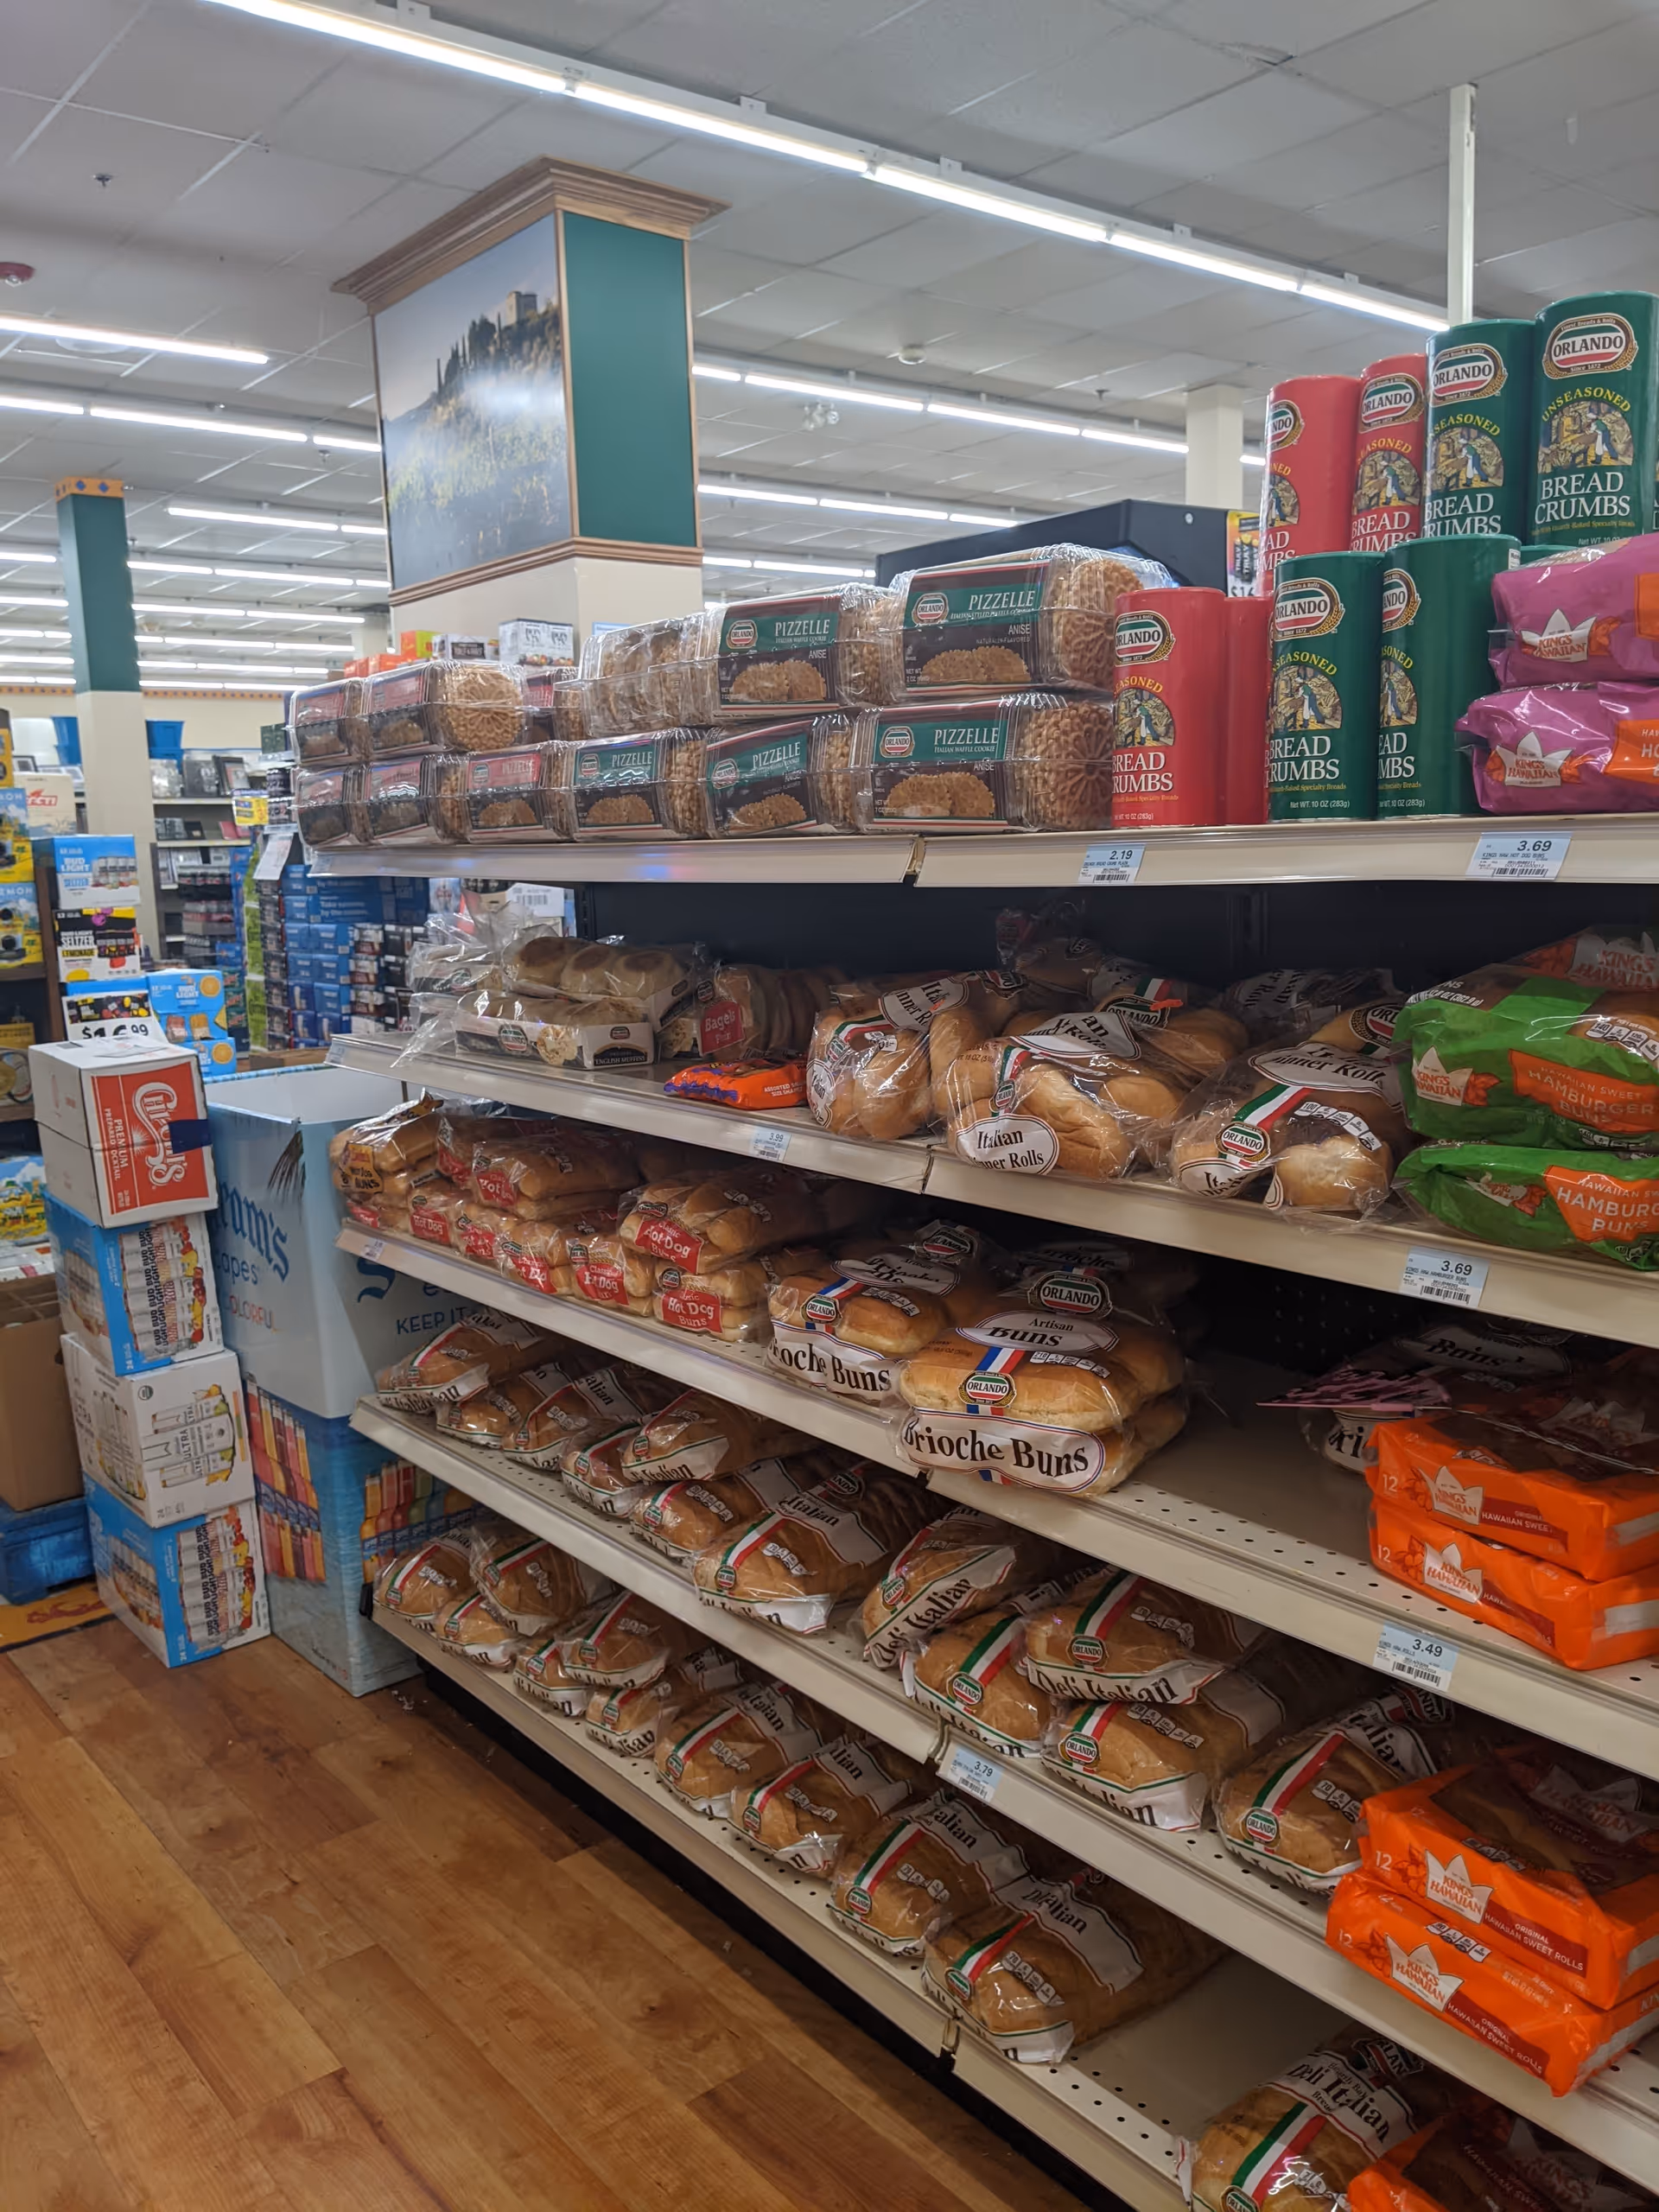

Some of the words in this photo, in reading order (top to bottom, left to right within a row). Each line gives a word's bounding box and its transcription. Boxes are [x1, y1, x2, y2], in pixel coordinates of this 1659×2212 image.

[1553, 335, 1624, 358] ORLANDO
[1433, 364, 1492, 386] ORLANDO
[1362, 391, 1413, 415] ORLANDO
[1541, 387, 1630, 422] UNSEASONED
[1541, 473, 1624, 499] BREAD
[1425, 493, 1493, 520] BREAD
[1535, 496, 1630, 524] CRUMBS
[1351, 512, 1410, 537] BREAD
[918, 603, 944, 613] ORLANDO
[969, 589, 1035, 611] PIZZELLE
[1275, 600, 1327, 620] ORLANDO
[731, 629, 753, 639] ORLANDO
[775, 620, 830, 636] PIZZELLE
[1008, 624, 1030, 634] ANISE
[1116, 629, 1161, 646] ORLANDO
[1539, 632, 1572, 649] KING'S
[809, 649, 827, 659] ANISE
[884, 738, 910, 747] ORLANDO
[934, 727, 999, 746] PIZZELLE
[753, 742, 800, 766] PIZZELLE
[1269, 736, 1331, 759] BREAD
[612, 752, 652, 767] PIZZELLE
[974, 761, 994, 771] ANISE
[1113, 752, 1166, 773] BREAD
[1515, 760, 1545, 770] KING'S
[1113, 772, 1173, 793] RUMBS
[1507, 767, 1559, 779] HAWAIIAN
[1109, 850, 1133, 861] 2.19
[1517, 840, 1552, 851] 3.69
[61, 936, 94, 946] SELTZER
[131, 1024, 149, 1036] 99
[704, 1010, 735, 1033] Bagels
[1594, 1022, 1610, 1032] 140
[594, 1056, 620, 1065] ENGLISH
[621, 1055, 646, 1064] MUFFINS
[1417, 1071, 1450, 1086] KING'S
[1540, 1067, 1595, 1093] HAWAIIAN
[1599, 1086, 1641, 1099] SWEET
[1528, 1069, 1656, 1115] HAMBURGER
[1559, 1100, 1612, 1123] BUNS
[114, 1119, 129, 1167] PREMIUM
[769, 1133, 784, 1141] 3.99
[976, 1130, 1024, 1149] Italian
[1223, 1130, 1262, 1151] ORLANDO
[1009, 1149, 1045, 1170] Rolls
[1578, 1178, 1639, 1198] HAWAIIAN
[1592, 1217, 1647, 1233] BUNS
[665, 1239, 691, 1257] Dog
[144, 1268, 154, 1286] BUD
[1441, 1260, 1472, 1275] 3.69
[147, 1288, 156, 1307] BUD
[1040, 1286, 1100, 1306] ORLANDO
[150, 1309, 159, 1327] BUD
[668, 1298, 684, 1313] Hot
[688, 1302, 715, 1319] Dog
[806, 1303, 836, 1317] ORLANDO
[397, 1313, 445, 1335] KEEP
[678, 1315, 707, 1326] Buns
[1029, 1317, 1074, 1332] Artisan
[988, 1325, 1063, 1347] Buns
[832, 1354, 891, 1392] Buns
[966, 1381, 1008, 1395] ORLANDO
[180, 1429, 194, 1460] ULTRA
[904, 1417, 1005, 1462] Brioche
[1012, 1439, 1089, 1478] Buns
[1382, 1474, 1397, 1493] 12
[779, 1495, 839, 1527] Italian
[1482, 1512, 1523, 1528] HAWAIIAN
[1377, 1546, 1391, 1562] 12
[883, 1583, 906, 1603] ORLANDO
[902, 1576, 973, 1636] Italian
[1072, 1645, 1102, 1656] ORLANDO
[1412, 1639, 1443, 1657] 3.49
[953, 1681, 981, 1701] ORLANDO
[1035, 1669, 1086, 1700] Deli
[1087, 1675, 1177, 1704] Italian
[1065, 1740, 1096, 1758] ORLANDO
[1347, 1713, 1406, 1773] talian
[974, 1761, 993, 1777] 3.79
[1321, 1782, 1332, 1791] 70
[1248, 1818, 1276, 1836] ORLANDO
[1376, 1851, 1392, 1871] 12
[1338, 1929, 1353, 1948] 12
[1484, 1912, 1522, 1941] HAWAIIAN
[1523, 1937, 1554, 1957] SWEET
[1555, 1952, 1584, 1971] ROLLS
[1515, 1923, 1549, 1944] ORIGINAL
[1407, 1960, 1440, 1985] KING'S
[1447, 2003, 1486, 2037] HAWAIIAN
[1487, 2032, 1515, 2054] SWEET
[1517, 2052, 1542, 2074] ROLLS
[1481, 2018, 1510, 2044] ORIGINAL
[1321, 2077, 1389, 2143] Italian
